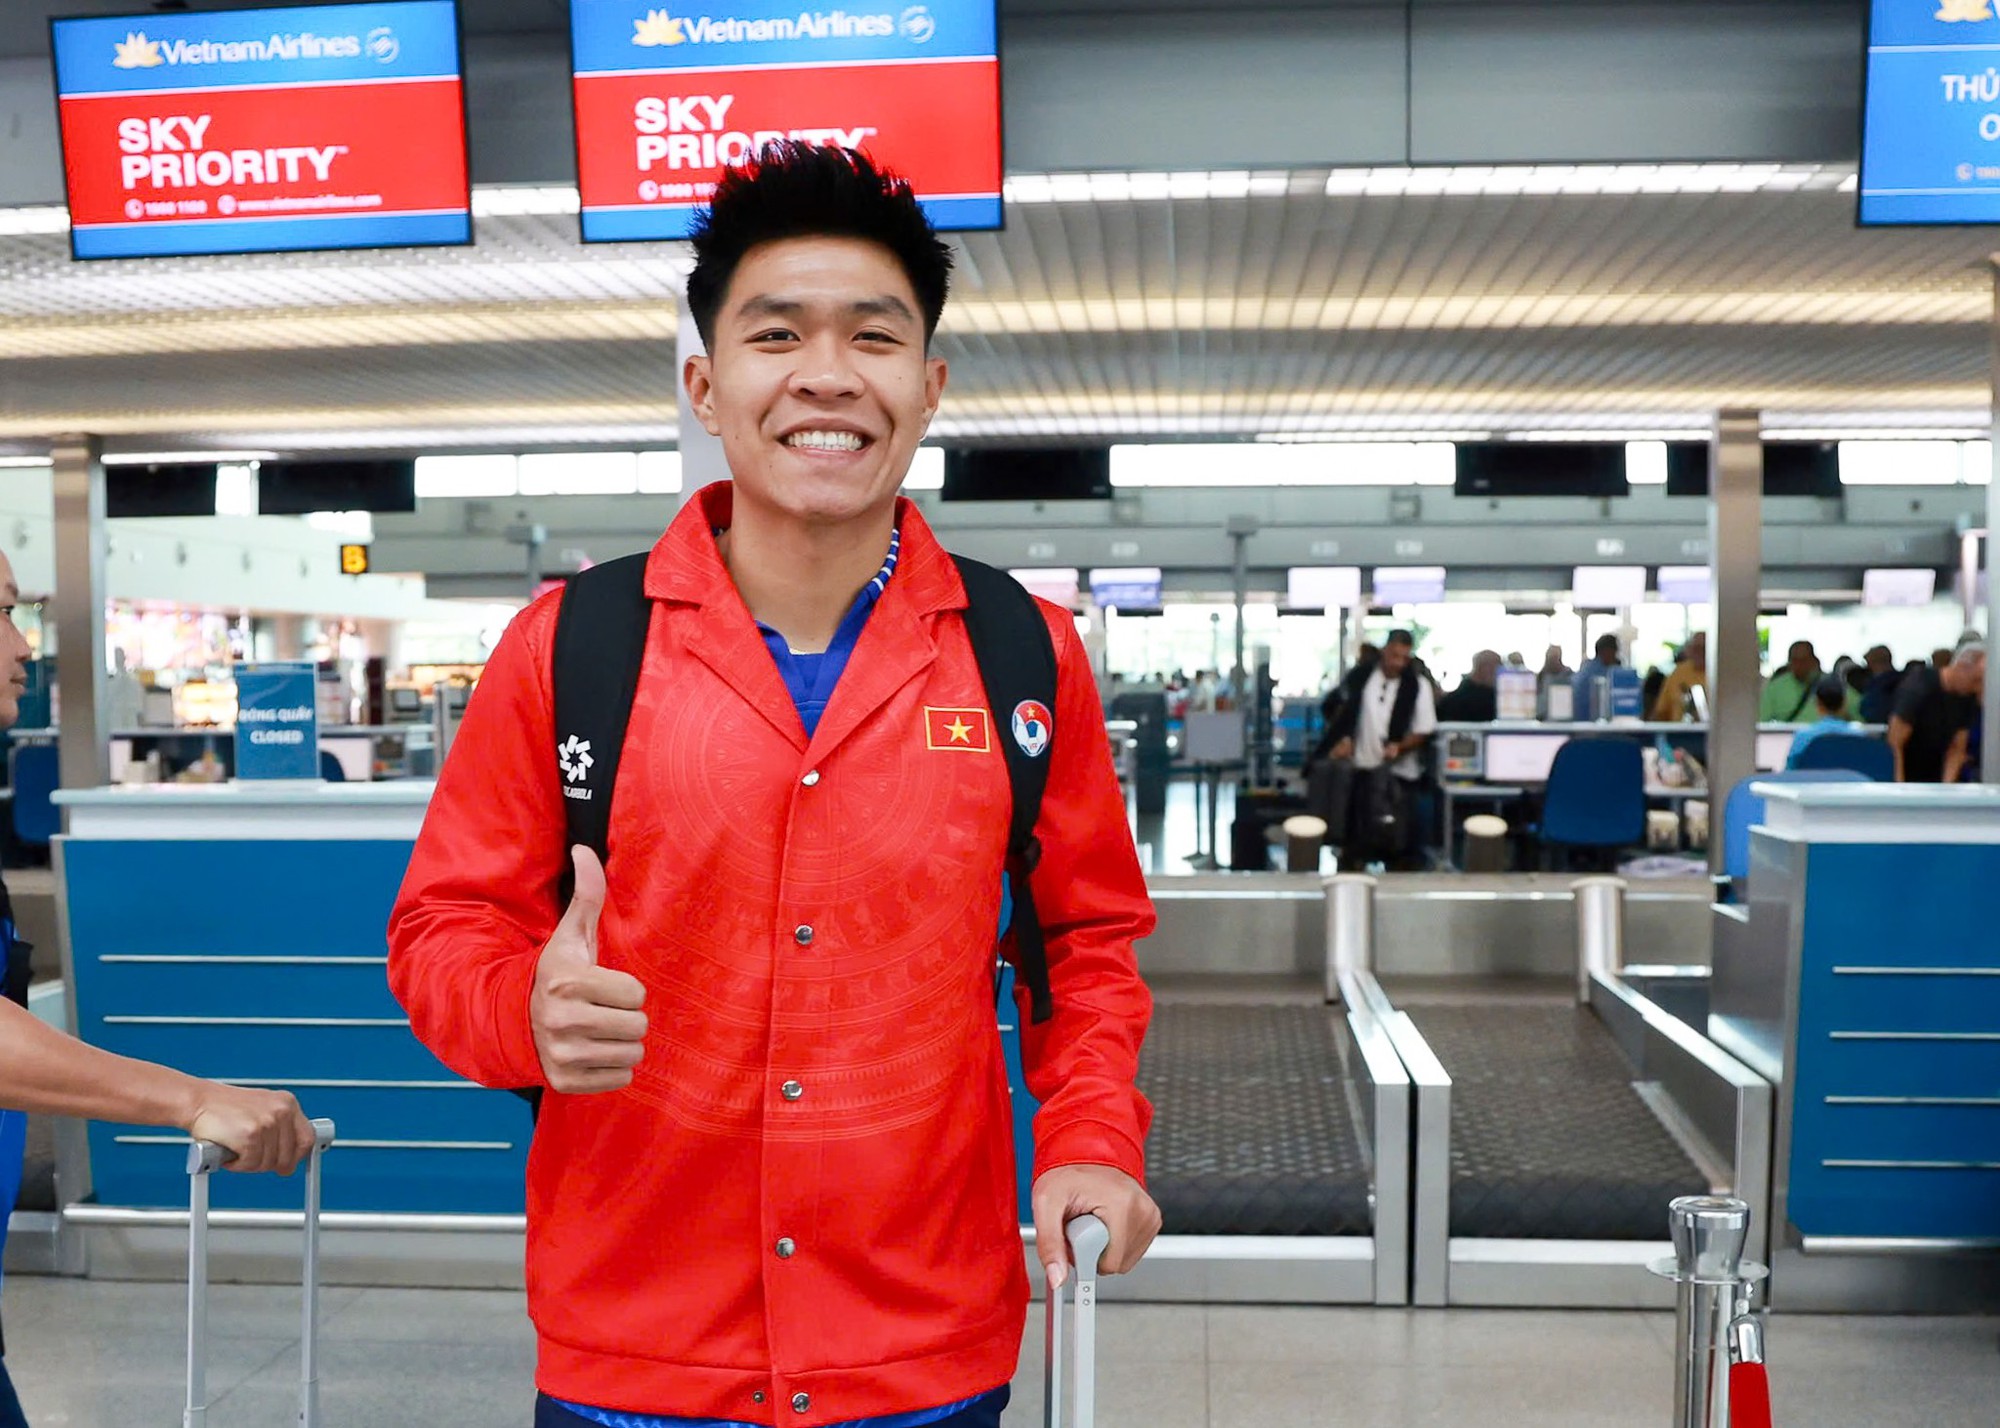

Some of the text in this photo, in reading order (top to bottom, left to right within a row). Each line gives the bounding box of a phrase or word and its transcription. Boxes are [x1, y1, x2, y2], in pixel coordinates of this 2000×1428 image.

[634, 95, 734, 134] SKY
[118, 115, 212, 153] SKY
[249, 729, 305, 745] CLOSED
